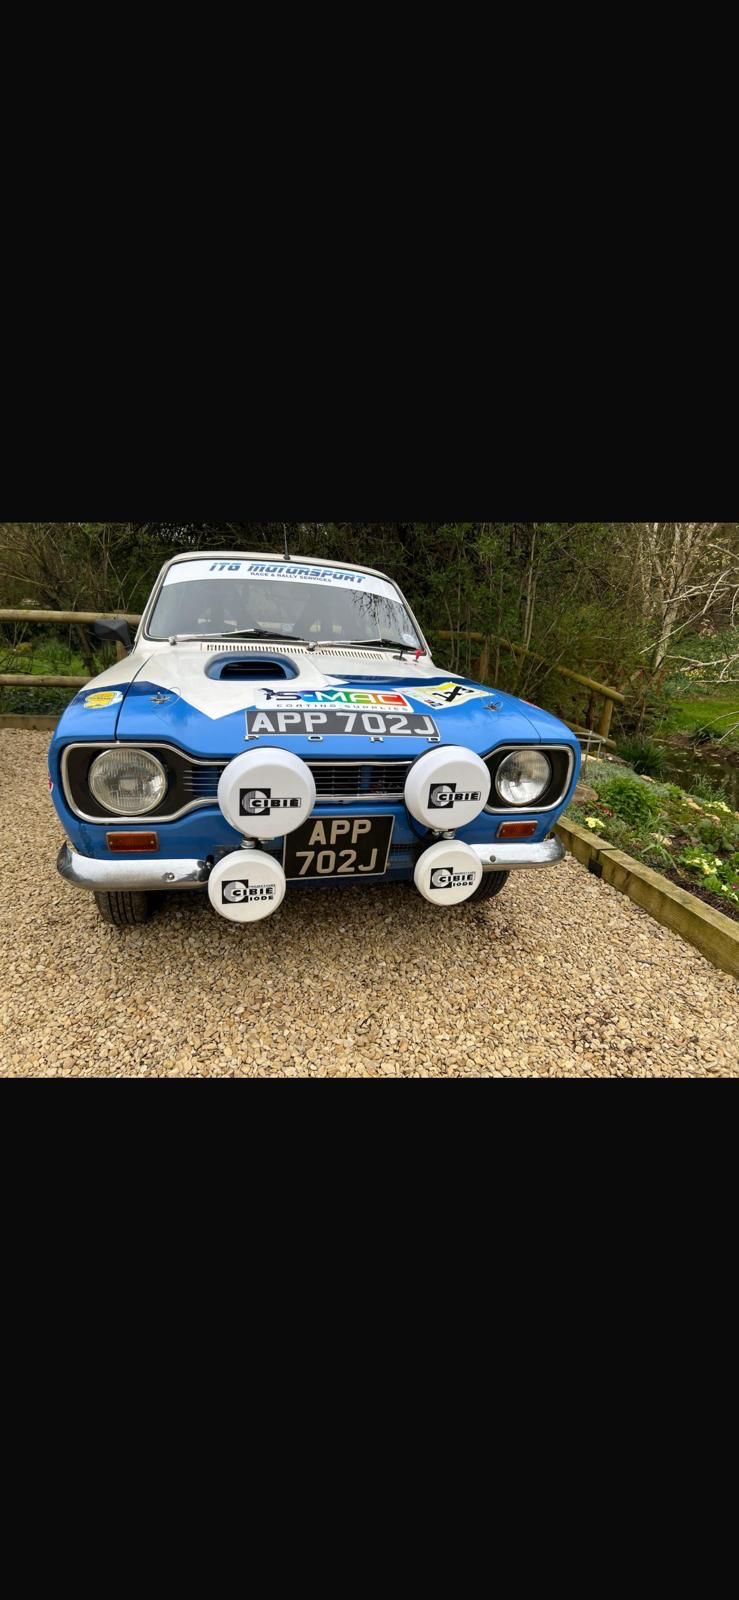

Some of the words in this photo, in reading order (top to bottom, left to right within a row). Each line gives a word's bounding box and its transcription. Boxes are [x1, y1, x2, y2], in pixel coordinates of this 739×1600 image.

[209, 562, 242, 572] ITG
[247, 563, 366, 584] MOTORSPORT
[299, 575, 332, 583] SERVICES
[251, 711, 328, 733] APP
[337, 712, 435, 735] 702J
[308, 819, 372, 846] APP
[296, 848, 378, 876] 702J
